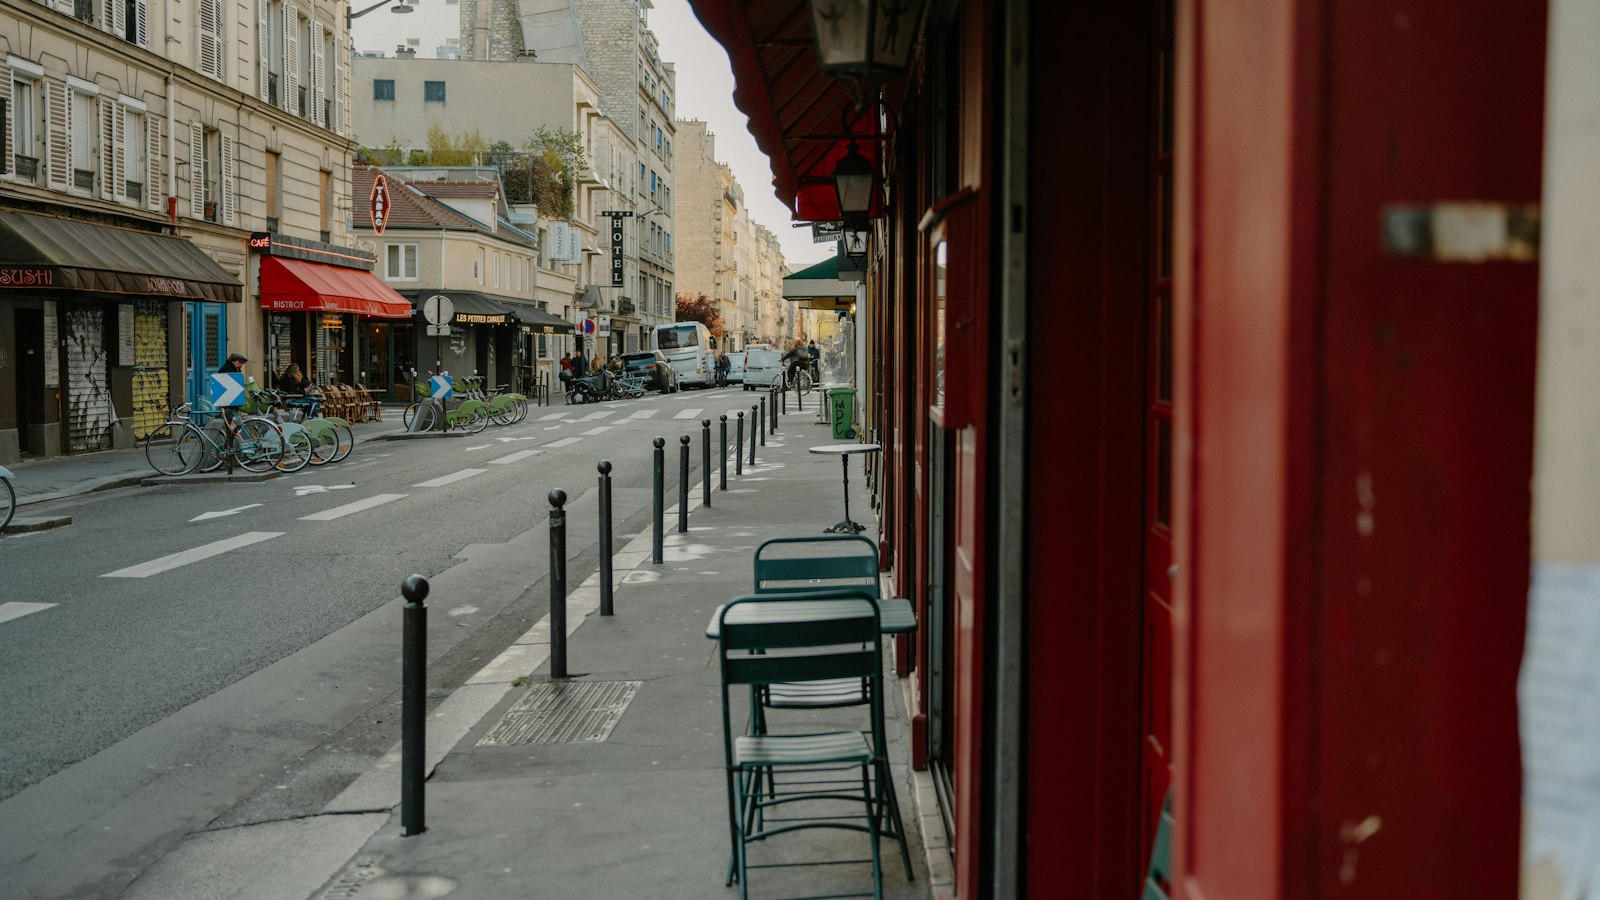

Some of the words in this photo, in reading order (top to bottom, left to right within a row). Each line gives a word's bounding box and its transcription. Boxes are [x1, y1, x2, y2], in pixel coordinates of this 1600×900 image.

[375, 186, 383, 226] TABAC
[251, 236, 270, 247] CAFÉ
[613, 219, 623, 282] HOTEL
[0, 269, 53, 285] SUSHI
[273, 300, 305, 309] BISTROT
[456, 313, 467, 322] LES
[467, 314, 487, 323] PETITES
